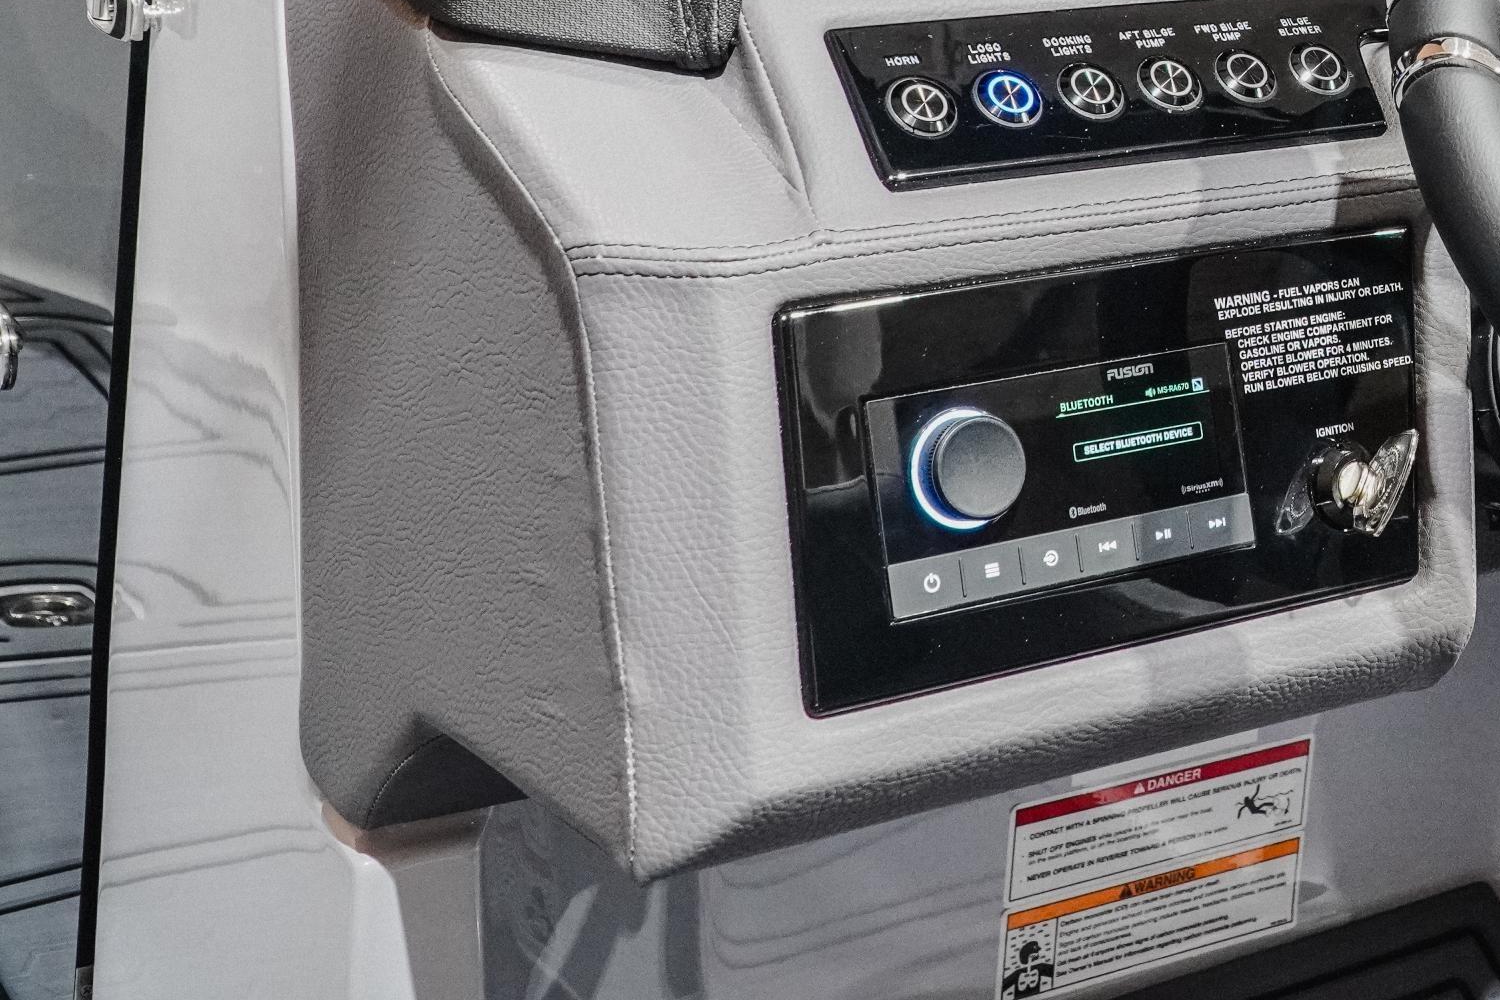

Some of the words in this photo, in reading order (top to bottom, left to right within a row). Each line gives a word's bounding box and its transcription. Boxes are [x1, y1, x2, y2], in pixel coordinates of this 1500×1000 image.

[1194, 24, 1218, 34] FWD
[1220, 21, 1252, 32] BILGE
[1280, 16, 1312, 27] BILGE
[1119, 30, 1140, 41] AFT
[1143, 27, 1176, 39] BILGE
[1212, 32, 1241, 42] PUMP
[1278, 25, 1323, 37] BLOWER
[968, 42, 1002, 54] LOGO
[1050, 45, 1093, 57] LIGHTS
[1136, 38, 1166, 49] PUMP
[885, 55, 920, 67] HORN
[968, 52, 1011, 65] LIGHTS
[1214, 290, 1271, 310] WARNING
[1279, 287, 1302, 299] FUEL
[1303, 281, 1339, 295] VAPORS
[1341, 277, 1360, 288] CAN
[1218, 305, 1261, 321] EXPLODE
[1263, 297, 1314, 312] RESULTING
[1315, 294, 1324, 305] IN
[1325, 289, 1356, 303] INJURY
[1358, 288, 1371, 298] OR
[1373, 282, 1403, 296] DEATH.
[1225, 325, 1262, 339] BEFORE
[1264, 316, 1309, 332] STARTING
[1310, 311, 1346, 325] ENGINE:
[1238, 334, 1269, 349] CHECK
[1272, 328, 1305, 343] ENGINE
[1307, 319, 1373, 337] COMPARTMENT
[1374, 314, 1393, 326] FOR
[1239, 344, 1286, 360] GASOLINE
[1287, 341, 1300, 351] OR
[1302, 335, 1341, 349] VAPORS.
[1241, 356, 1284, 371] OPERATE
[1286, 349, 1325, 363] BLOWER
[1326, 346, 1344, 357] FOR
[1346, 344, 1351, 353] 4
[1352, 337, 1393, 352] MINUTES.
[1242, 368, 1275, 383] VERIFY
[1277, 360, 1316, 376] BLOWER
[1317, 352, 1370, 370] OPERATION.
[1244, 382, 1264, 395] RUN
[1266, 375, 1305, 391] BLOWER
[1307, 368, 1339, 383] BELOW
[1341, 361, 1381, 376] CRUISING
[1383, 355, 1413, 369] SPEED.
[1157, 382, 1189, 394] MS-RA670
[1060, 395, 1114, 413] BLUETOOTH
[1315, 421, 1355, 439] IGNITION
[1084, 441, 1115, 456] SELECT
[1116, 431, 1163, 450] BLUETOOTH
[1164, 426, 1193, 441] DEVICE
[1077, 502, 1107, 516] Bluetooth
[1147, 768, 1201, 791] DANGER
[1133, 867, 1196, 894] WARNING
